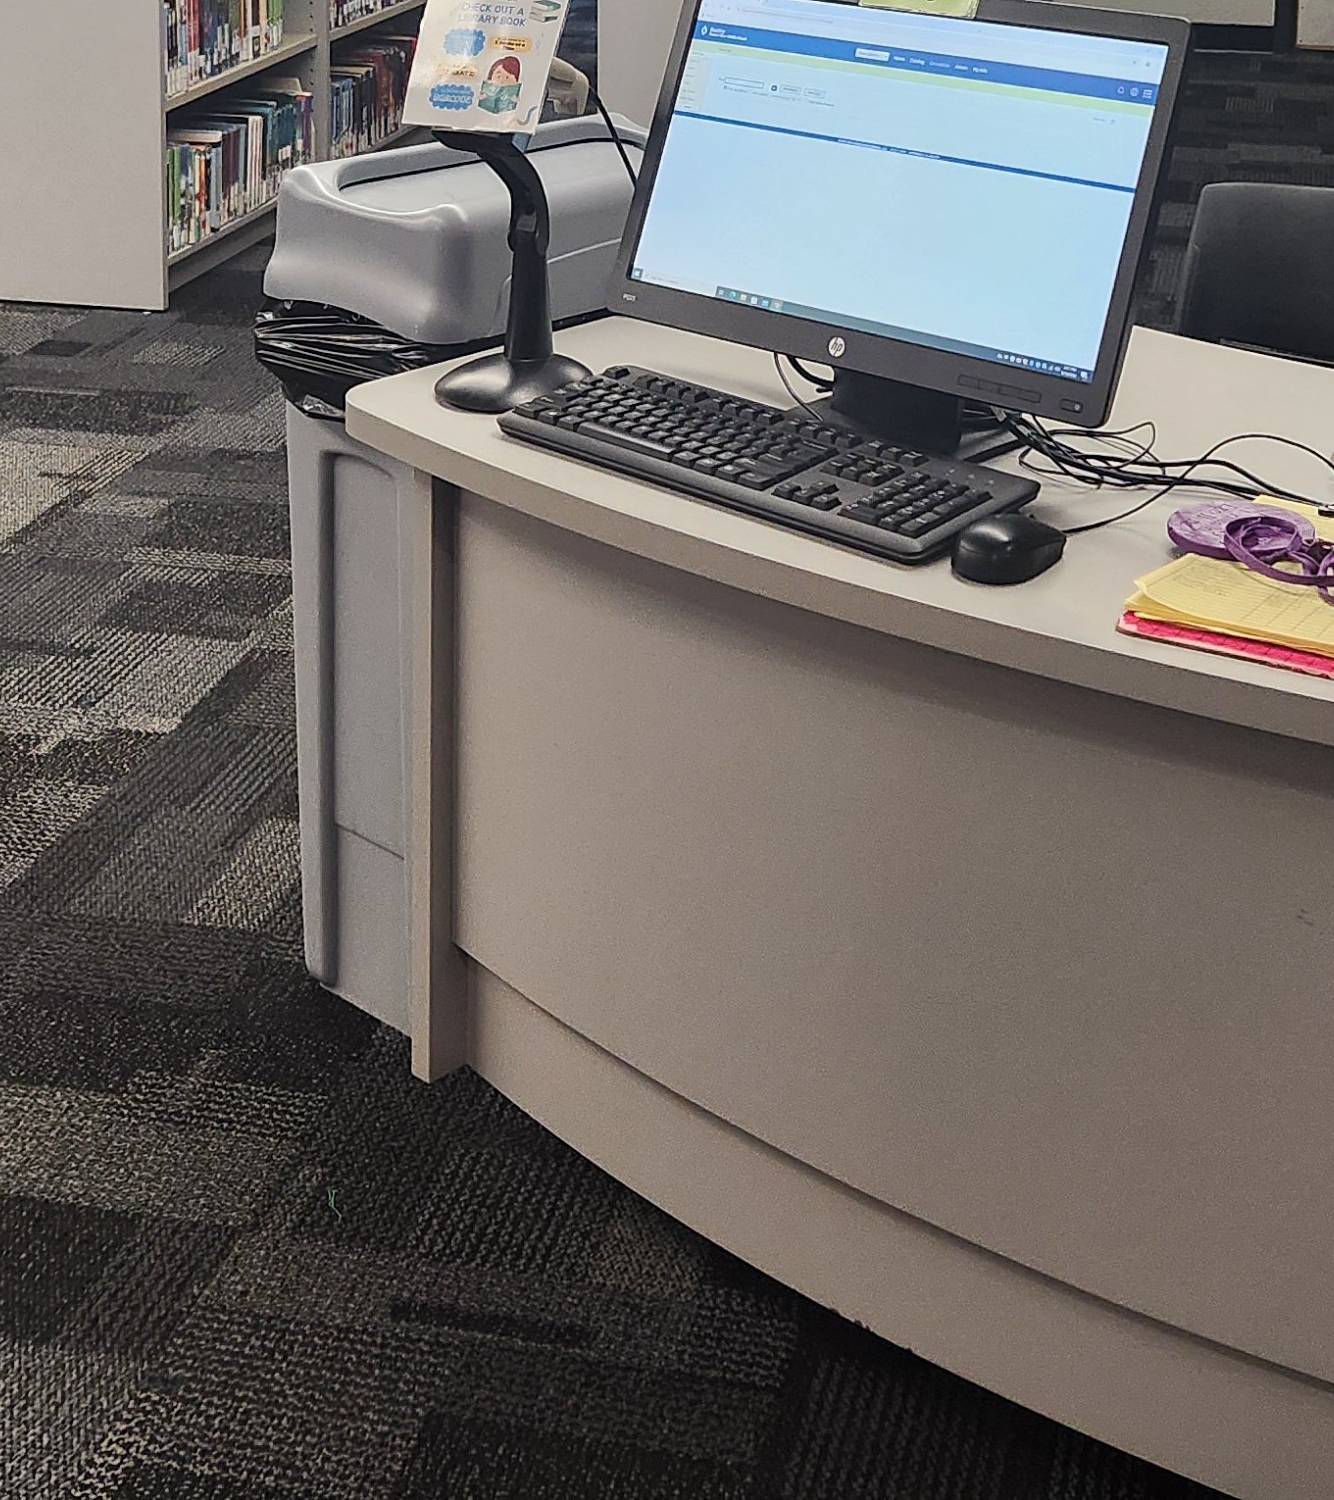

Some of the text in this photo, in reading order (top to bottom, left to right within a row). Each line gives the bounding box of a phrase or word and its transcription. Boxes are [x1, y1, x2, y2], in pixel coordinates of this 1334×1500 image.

[461, 2, 525, 16] CHECK OUT A
[499, 16, 526, 28] BOOK
[829, 337, 845, 357] hp
